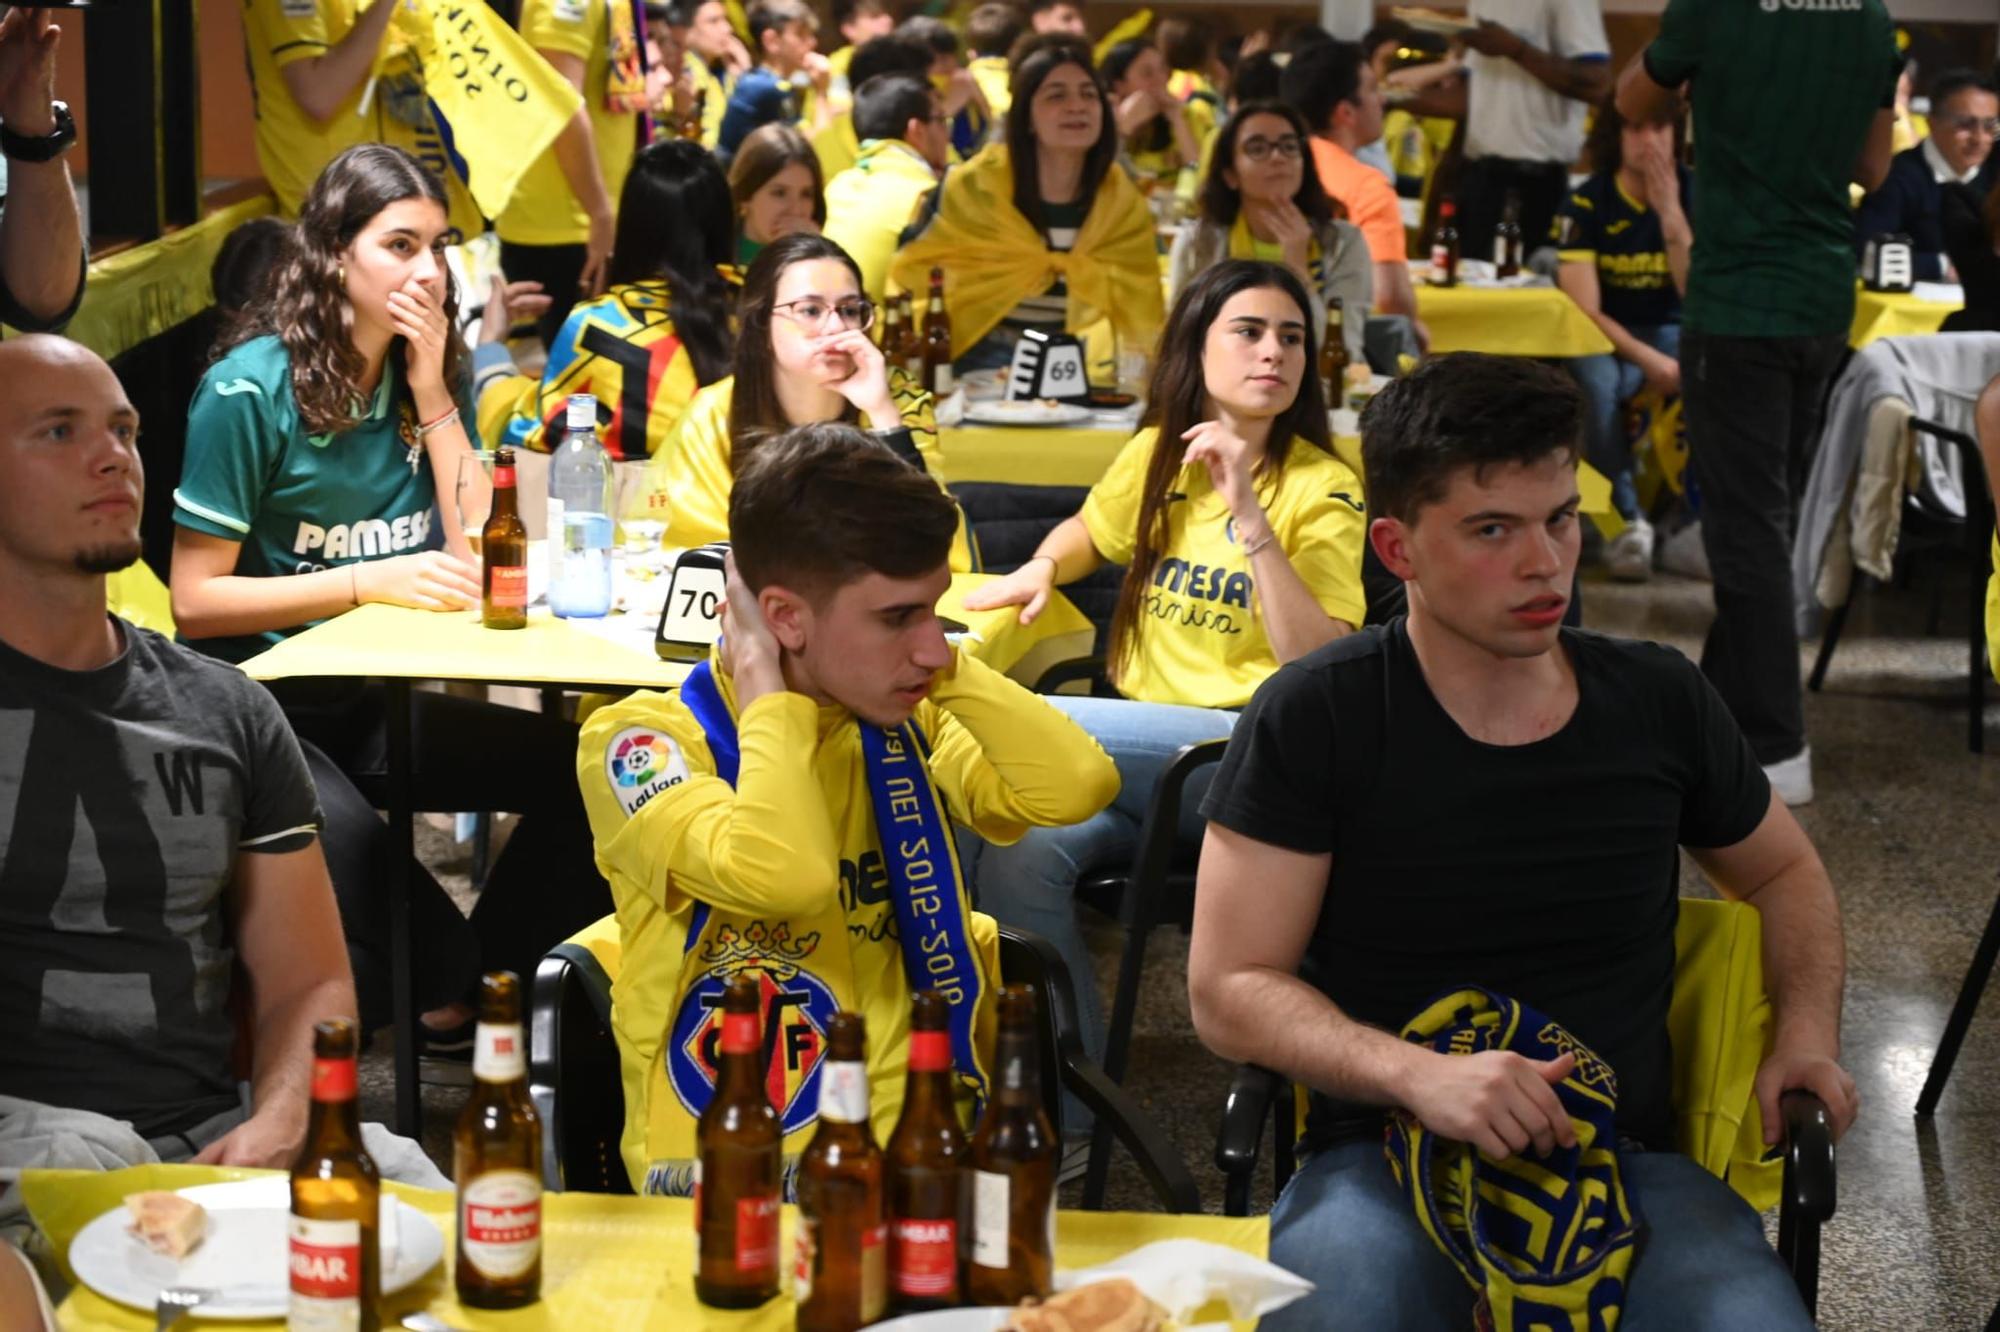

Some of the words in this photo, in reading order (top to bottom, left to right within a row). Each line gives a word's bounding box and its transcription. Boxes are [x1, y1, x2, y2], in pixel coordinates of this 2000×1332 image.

[1050, 360, 1078, 381] 69
[679, 589, 718, 620] 70
[153, 751, 205, 816] W
